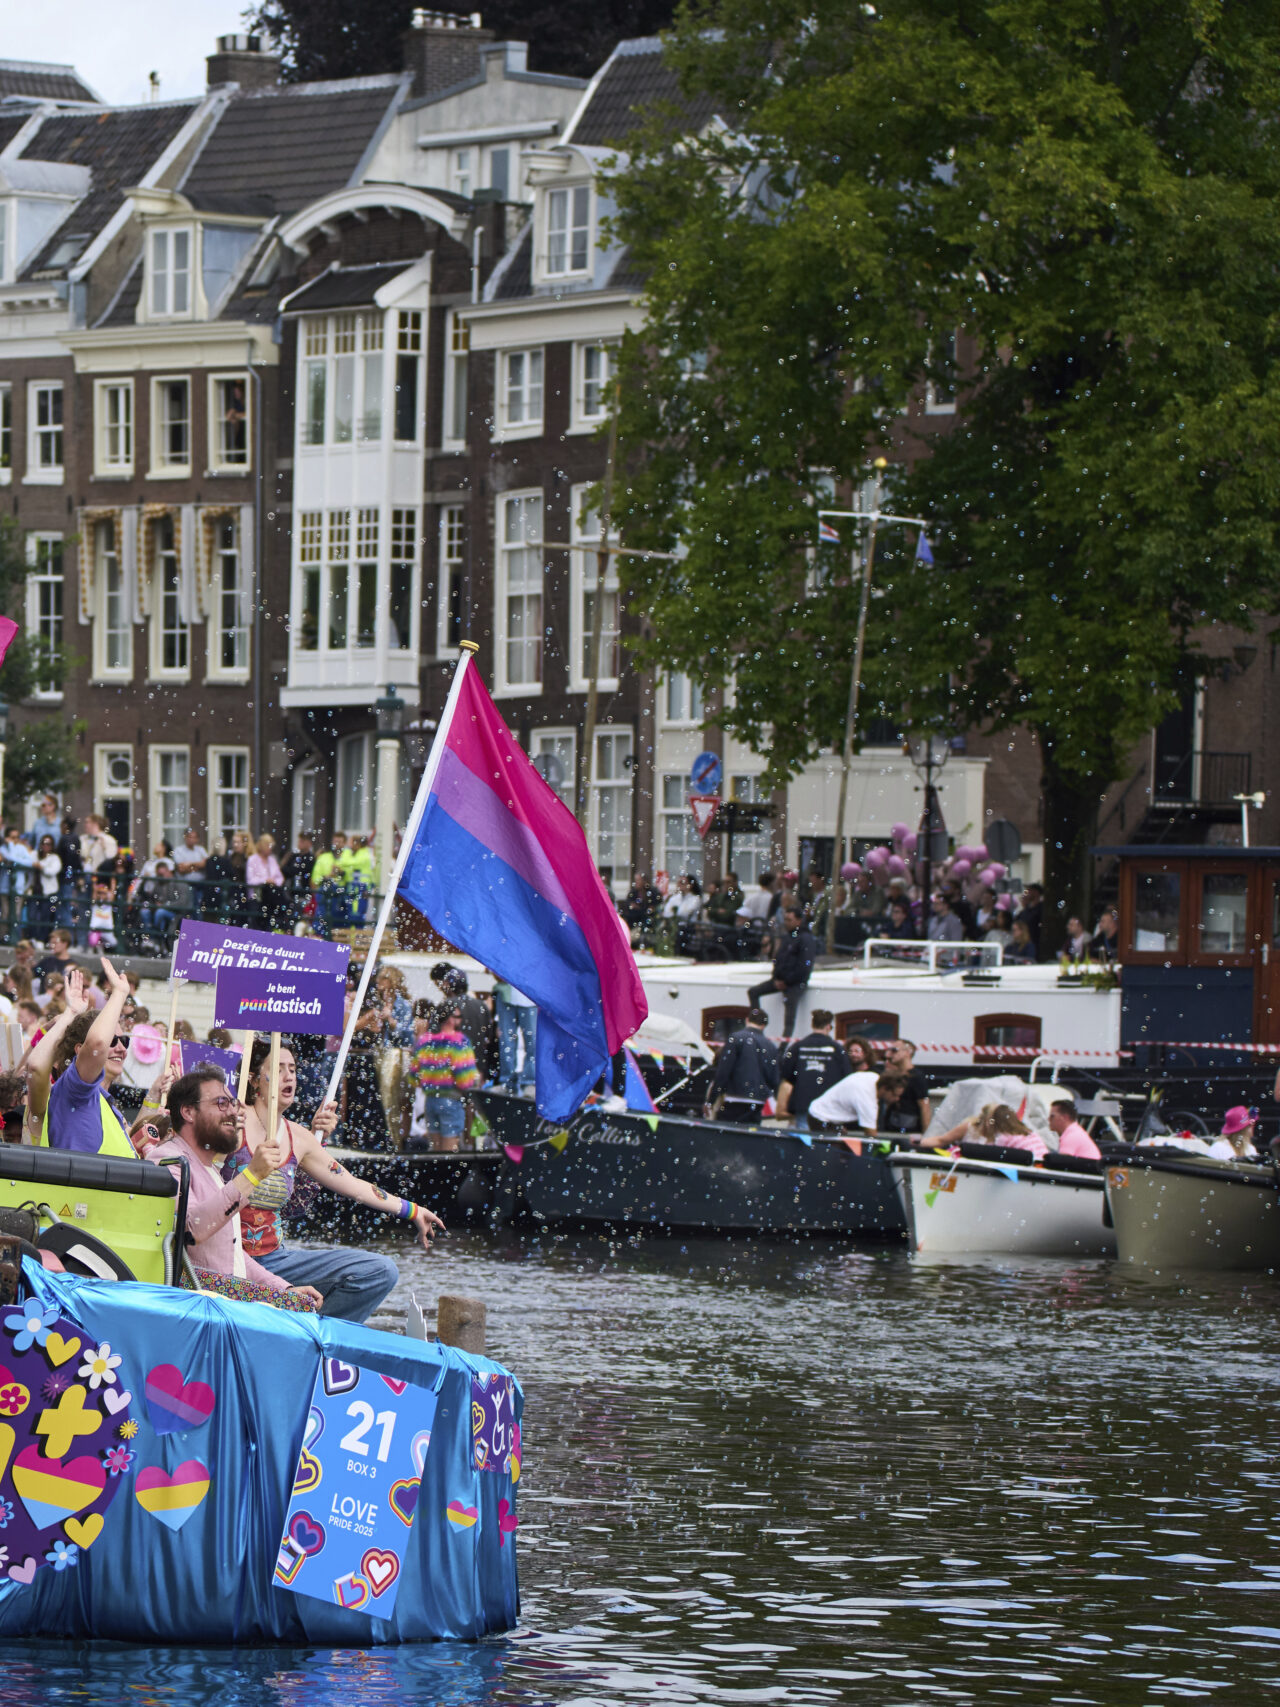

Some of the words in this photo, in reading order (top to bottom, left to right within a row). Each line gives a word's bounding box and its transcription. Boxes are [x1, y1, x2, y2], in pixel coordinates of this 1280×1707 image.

[191, 948, 233, 969] mijn
[223, 939, 249, 951] Deze
[250, 943, 273, 955] fase
[275, 947, 305, 960] duurt
[266, 983, 276, 993] Je
[277, 983, 296, 994] bent
[238, 997, 322, 1015] pantastisch
[340, 1400, 397, 1463] 21
[347, 1459, 368, 1476] BOX
[370, 1467, 377, 1479] 3
[331, 1493, 378, 1525] LOVE
[328, 1515, 352, 1531] PRIDE
[354, 1523, 374, 1537] 2025
